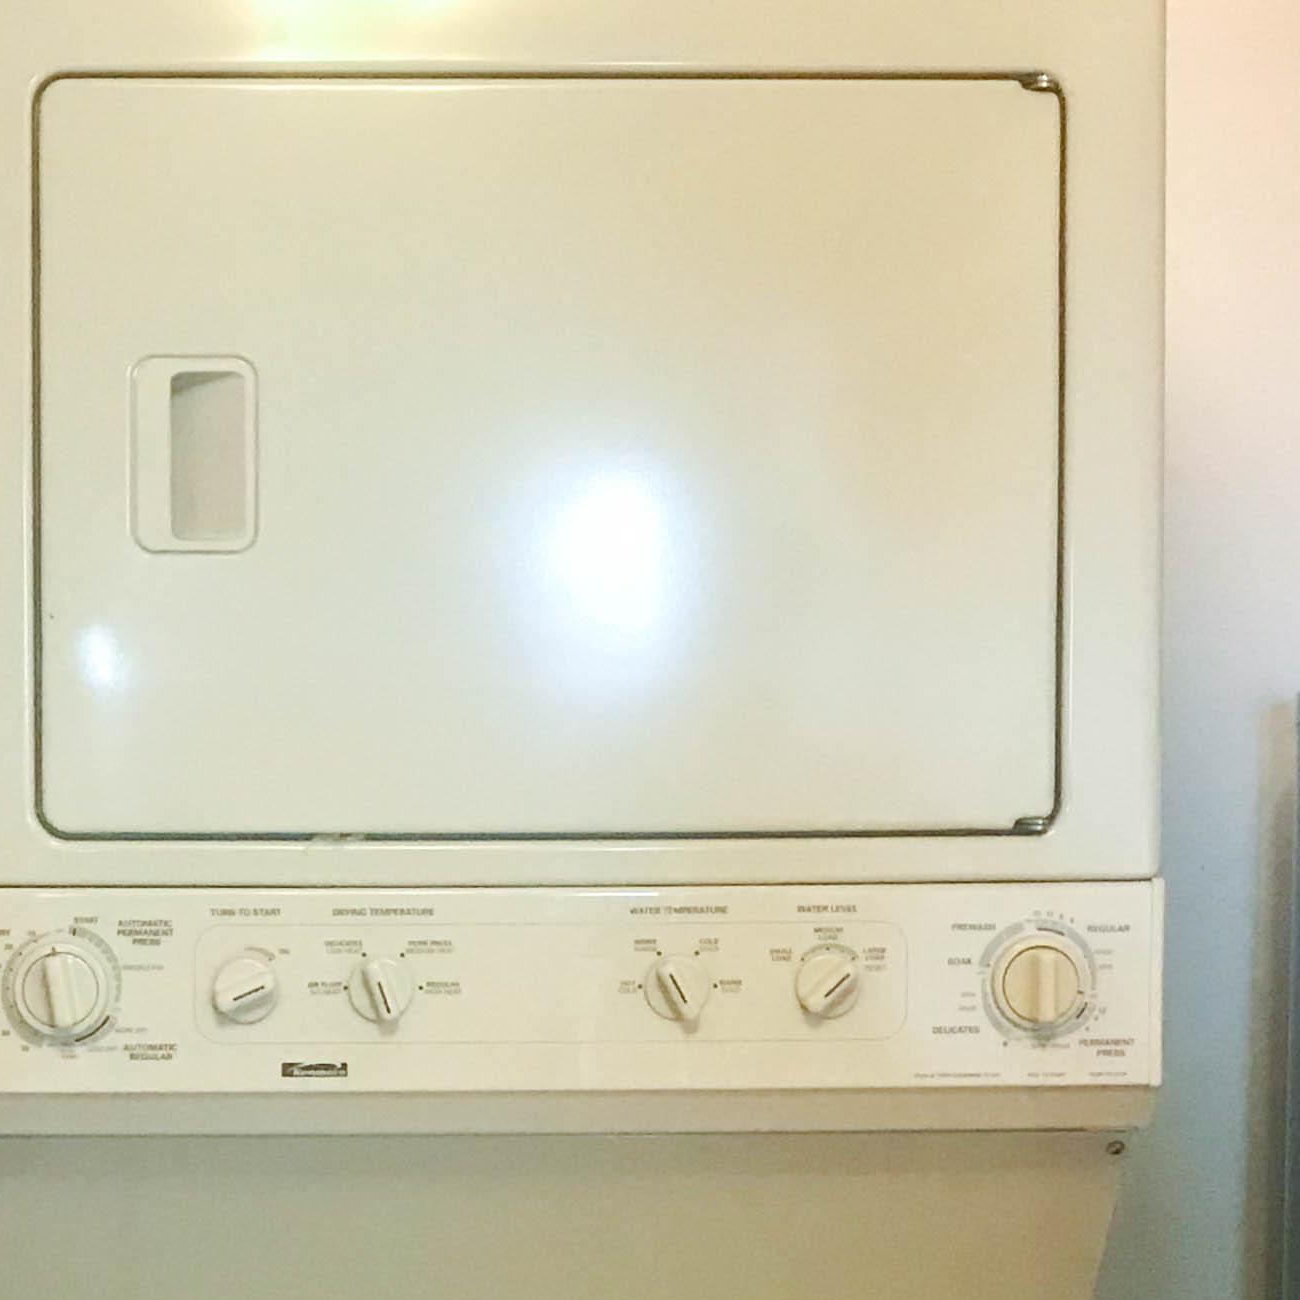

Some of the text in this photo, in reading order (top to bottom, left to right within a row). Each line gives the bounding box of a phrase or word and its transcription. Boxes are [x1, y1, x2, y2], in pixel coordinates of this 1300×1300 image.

[238, 908, 251, 917] TO
[252, 908, 281, 917] START
[369, 908, 435, 917] TEMPERATURE
[663, 905, 729, 915] TEMPERATURE
[117, 919, 173, 928] AUTOMATIC
[116, 928, 174, 937] PERMANENT
[931, 1026, 981, 1035] DELICATES
[1078, 1038, 1135, 1047] PERMANENT
[123, 1043, 178, 1052] AUTOMATIC
[129, 1052, 174, 1061] REGULAR
